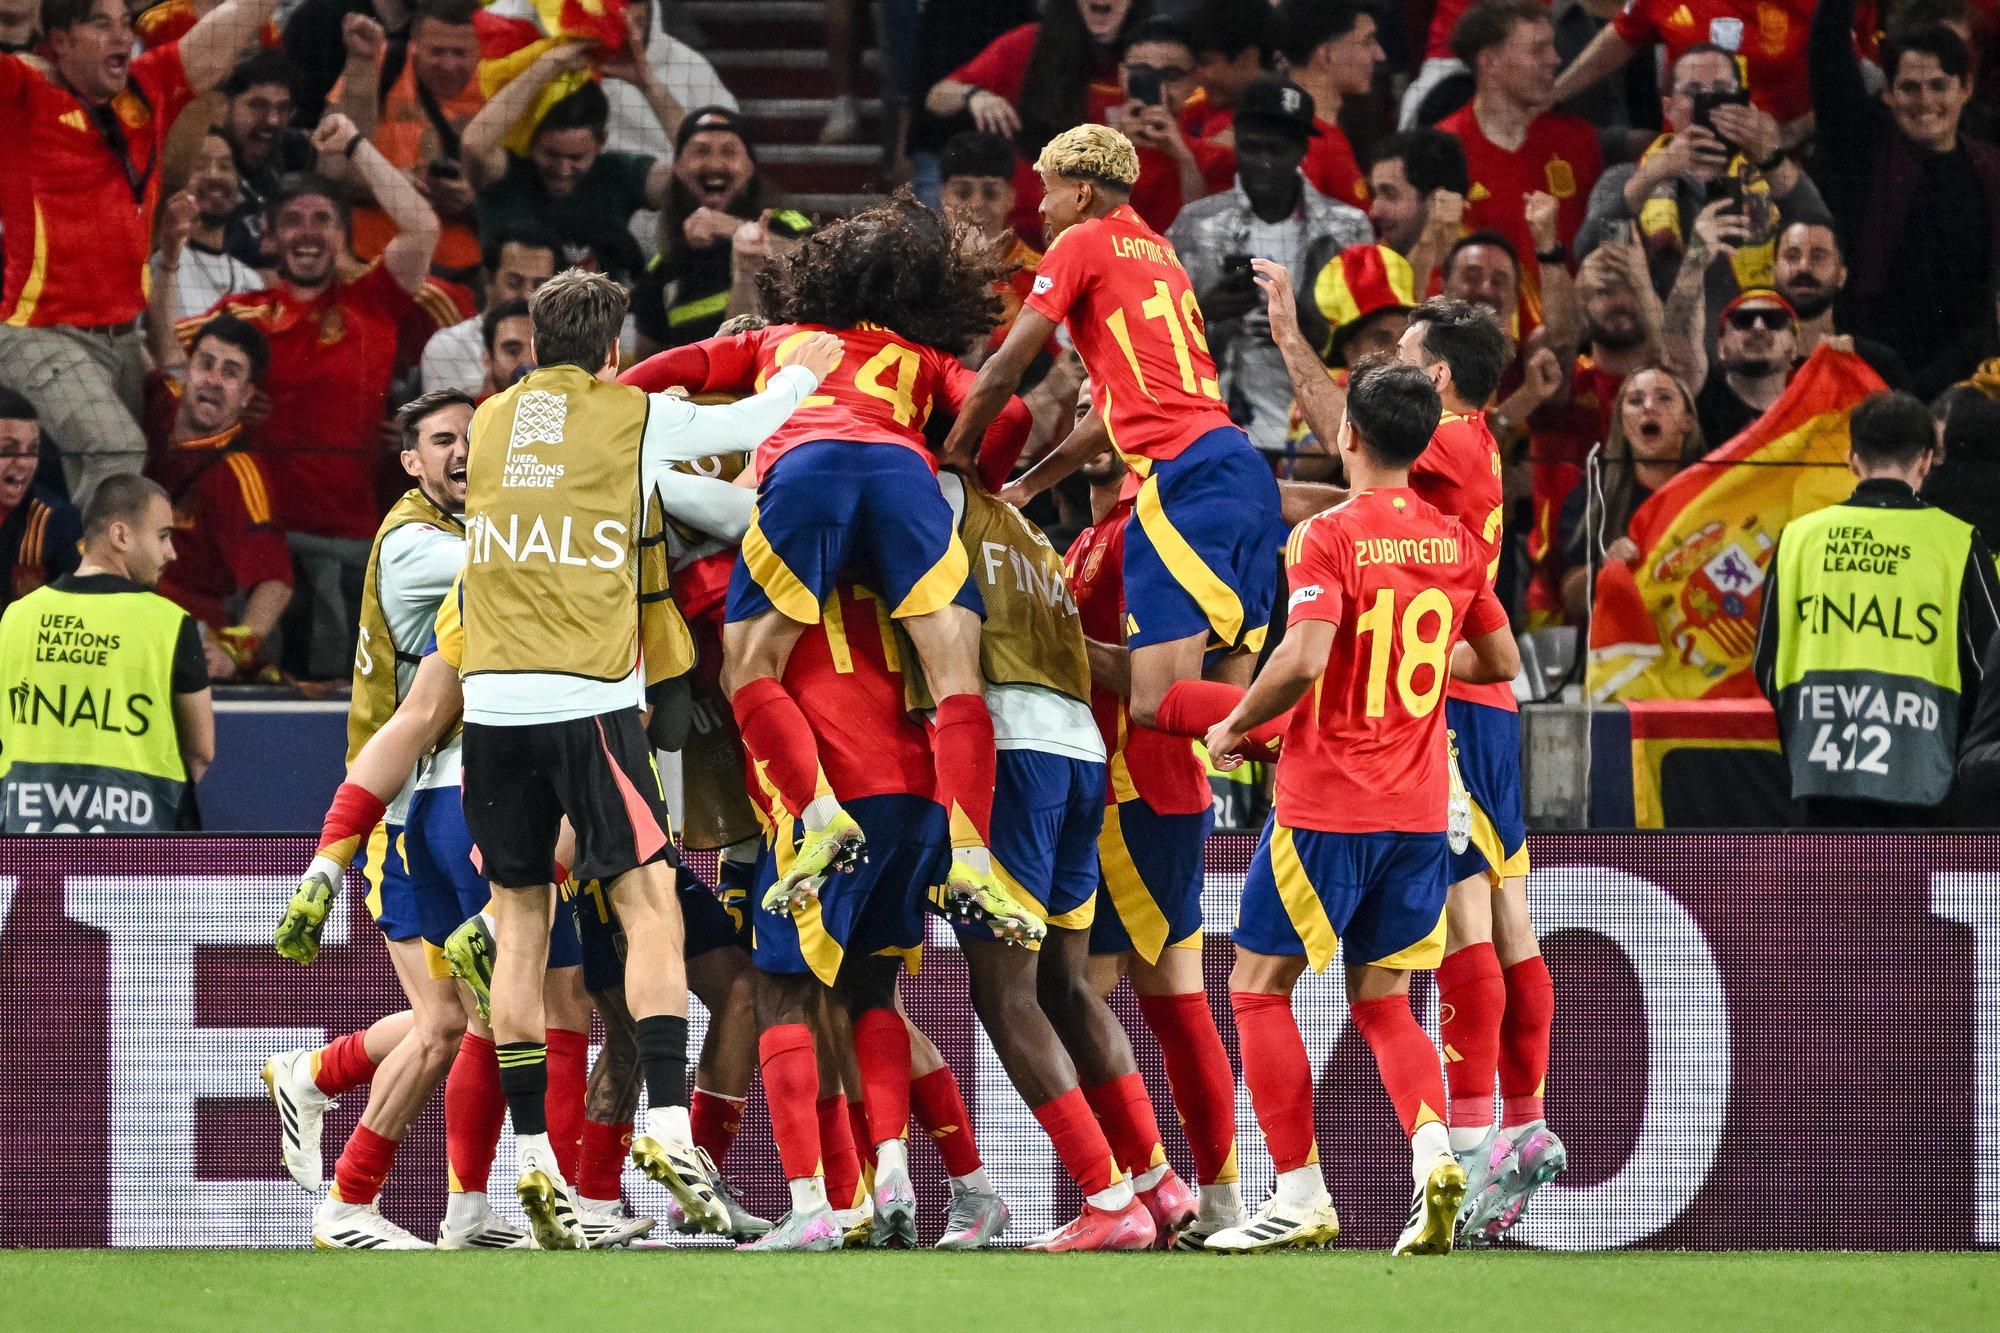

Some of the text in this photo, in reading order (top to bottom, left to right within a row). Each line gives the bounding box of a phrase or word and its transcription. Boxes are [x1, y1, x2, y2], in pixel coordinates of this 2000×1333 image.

[1112, 234, 1167, 266] LAMINE
[511, 454, 538, 464] UEFA
[504, 464, 565, 476] NATIONS
[502, 475, 555, 488] LEAGUE
[1828, 526, 1873, 540] UEFA
[1355, 537, 1459, 566] ZUBIMENDI
[1825, 541, 1911, 560] NATIONS
[1823, 557, 1898, 576] LEAGUE
[41, 613, 84, 630] UEFA
[38, 631, 121, 650] NATIONS
[36, 647, 108, 666] LEAGUE
[1356, 587, 1454, 718] 18
